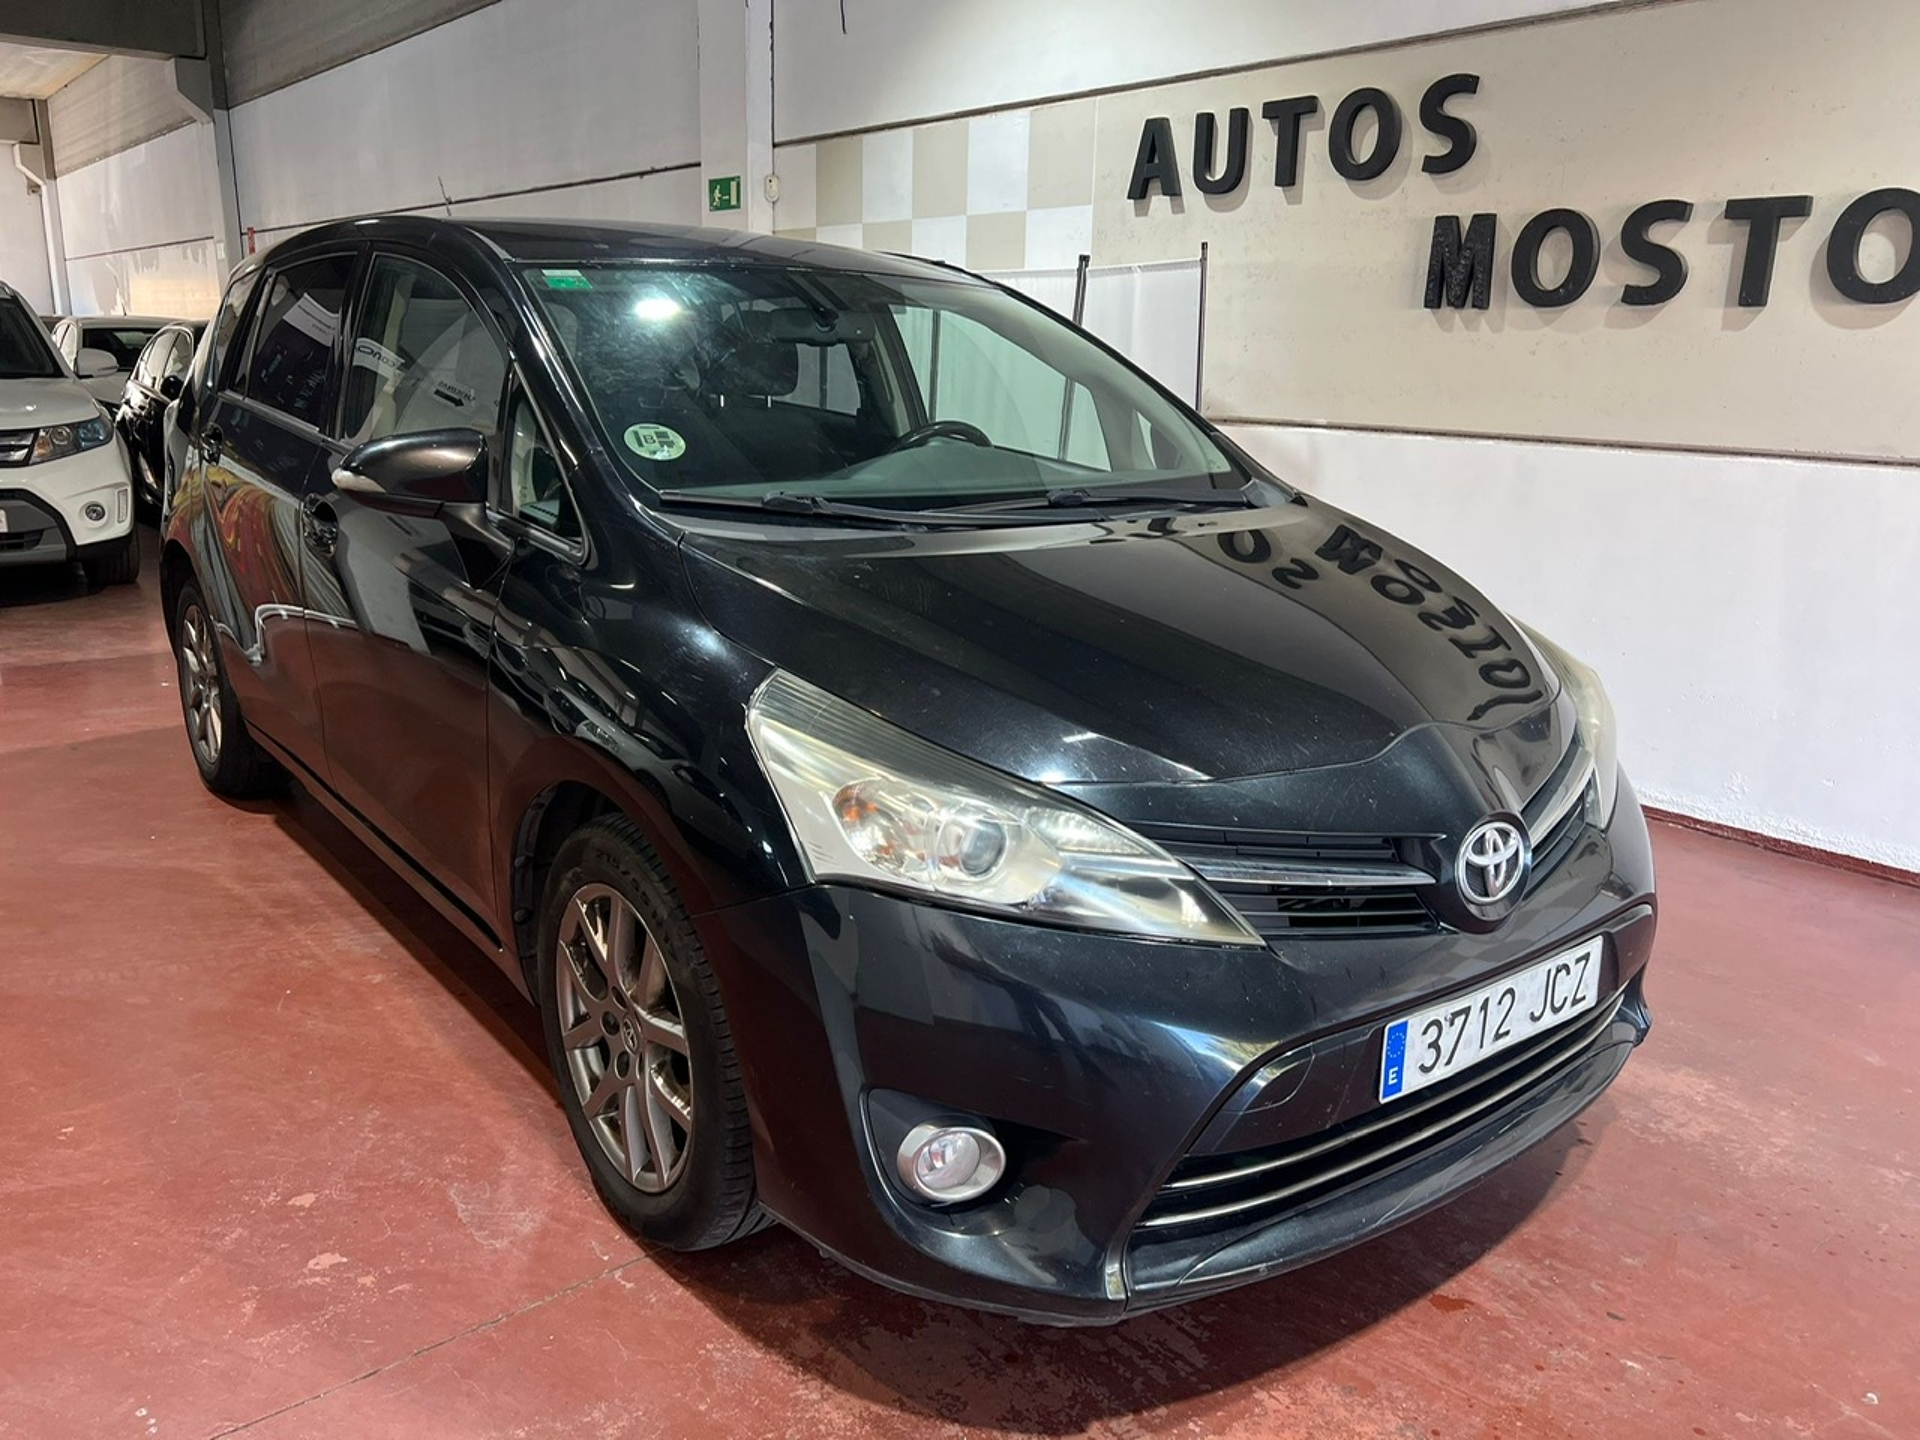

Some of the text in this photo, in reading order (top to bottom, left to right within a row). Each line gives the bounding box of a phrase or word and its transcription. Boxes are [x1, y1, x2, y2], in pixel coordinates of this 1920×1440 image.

[1127, 73, 1480, 200] AUTOS
[1424, 187, 1920, 310] MOSTO
[1417, 952, 1592, 1074] 3712 JCZ
[1387, 1066, 1400, 1086] E
